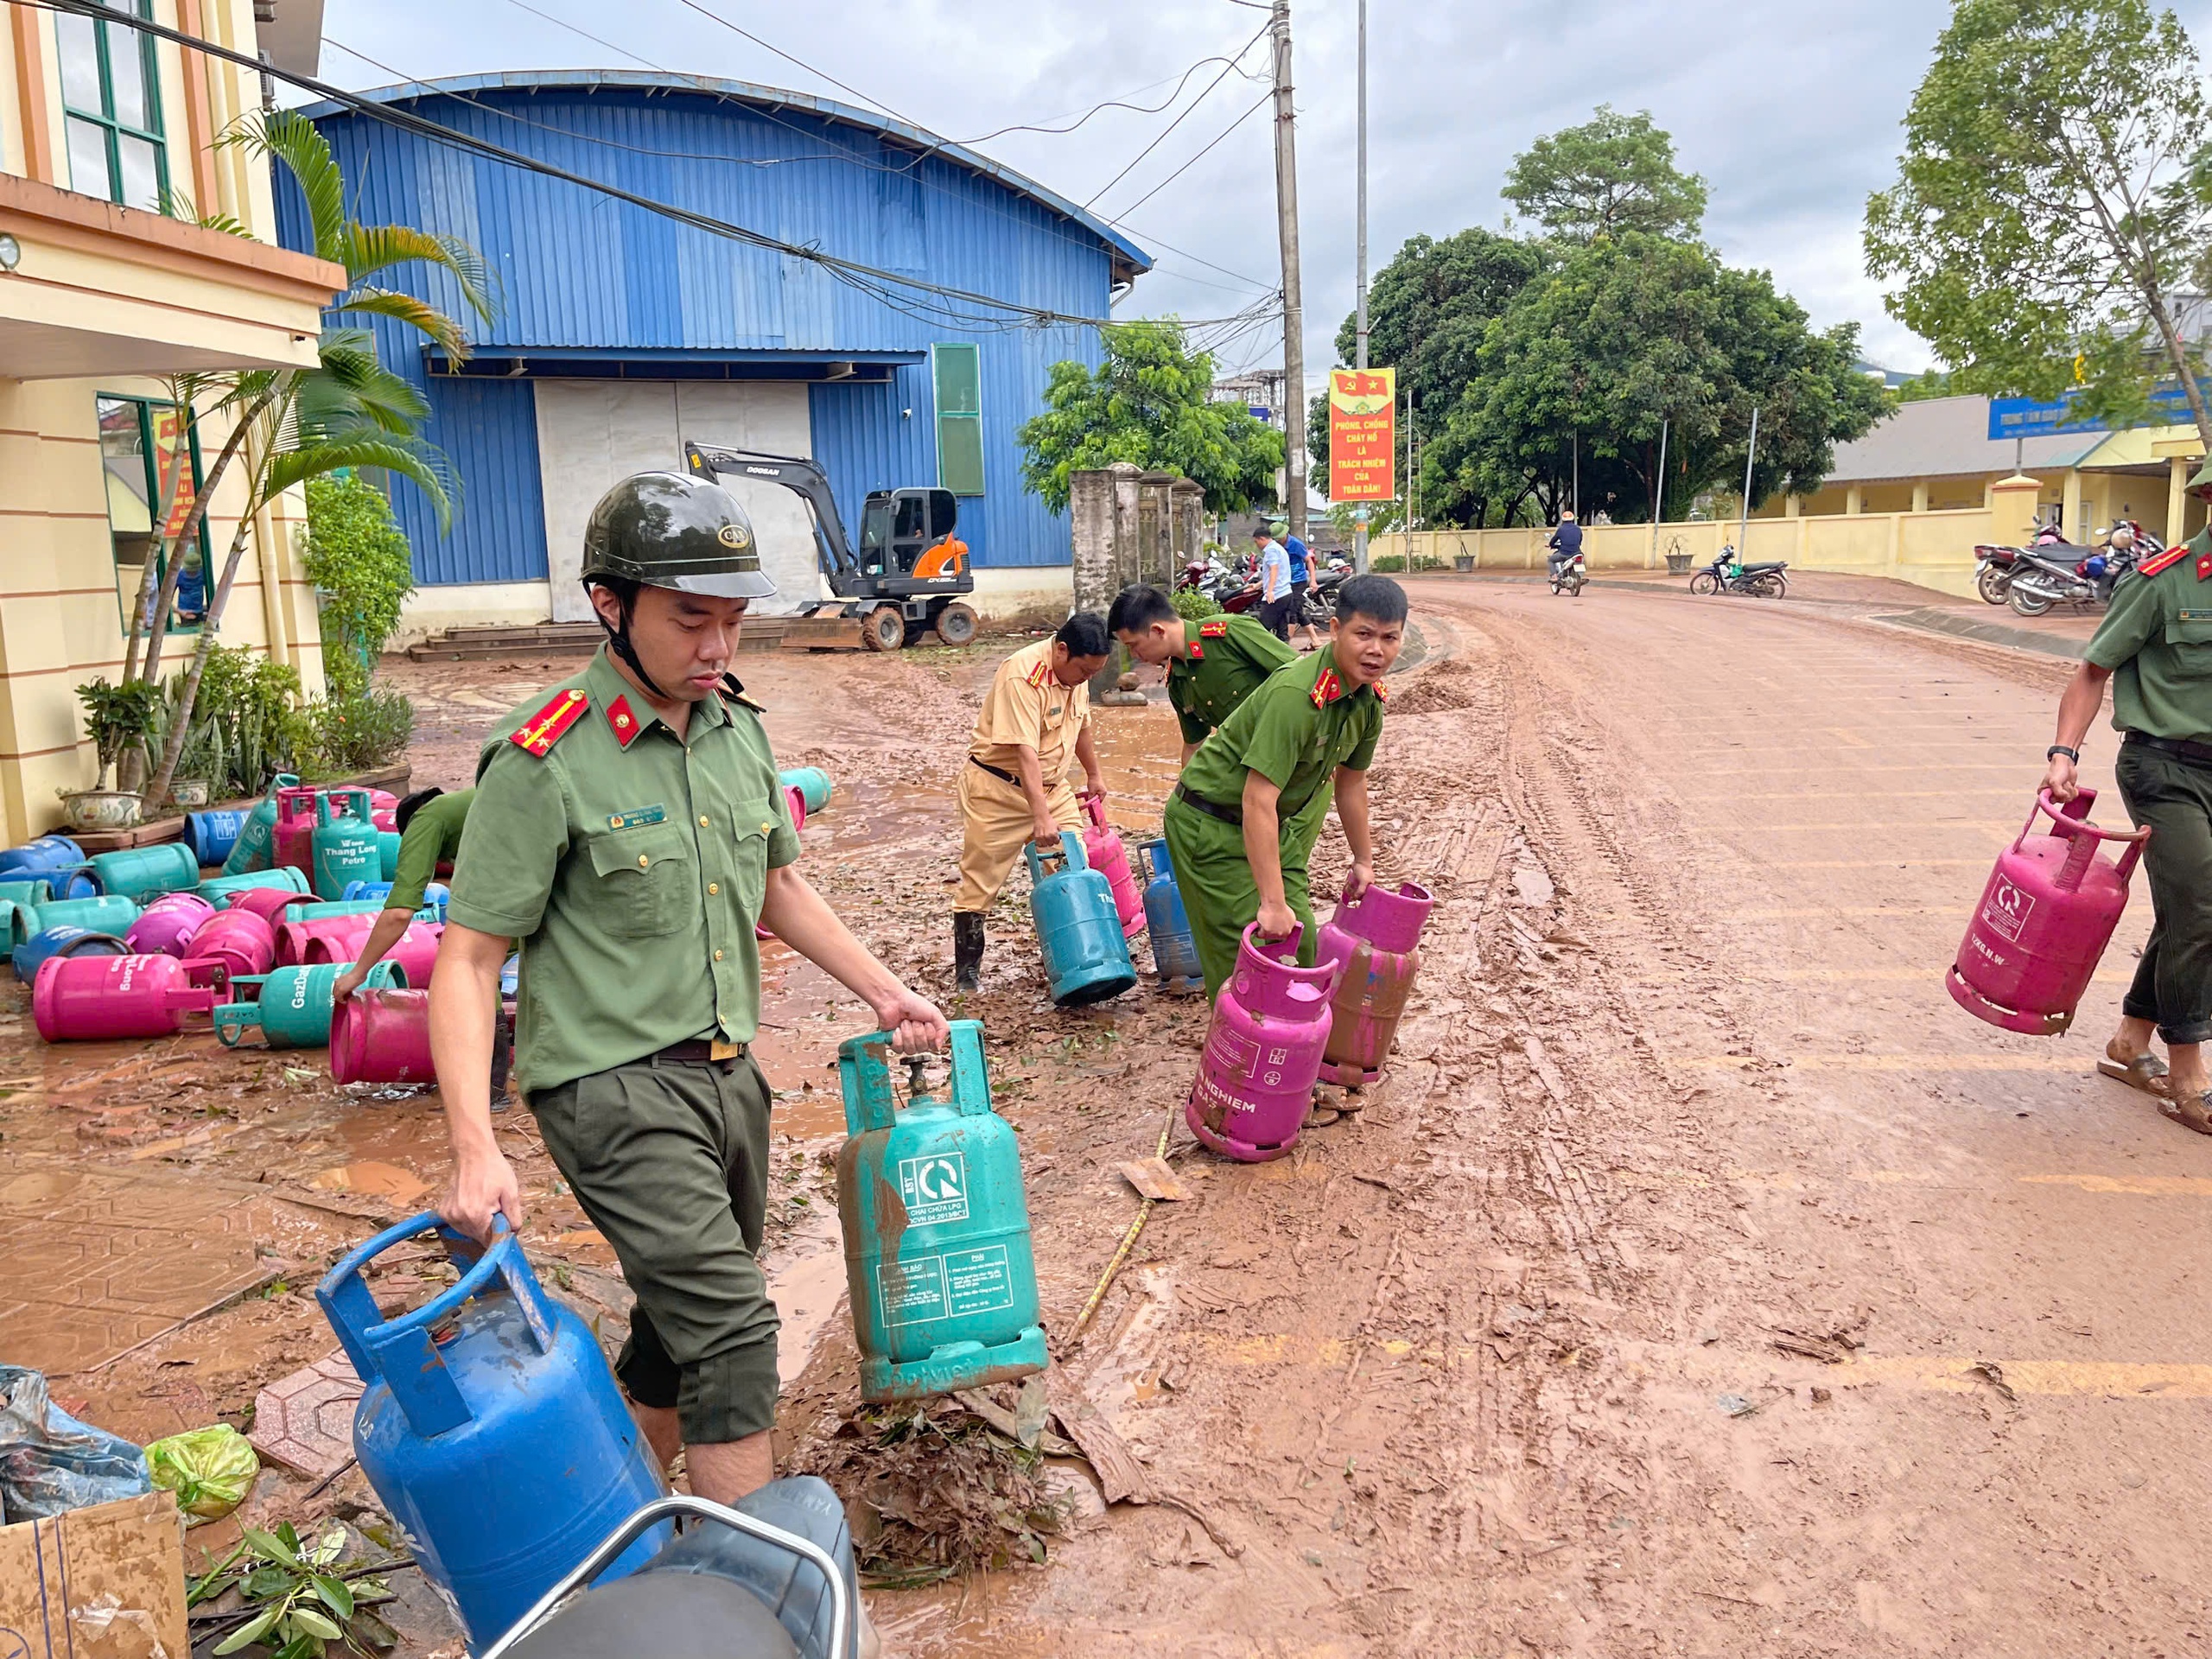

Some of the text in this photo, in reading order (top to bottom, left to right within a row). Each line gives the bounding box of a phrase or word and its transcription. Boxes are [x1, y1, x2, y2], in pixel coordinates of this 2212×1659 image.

[747, 466, 779, 476] DOOSAN
[325, 845, 377, 856] Thang Long
[948, 1202, 963, 1211] LPG
